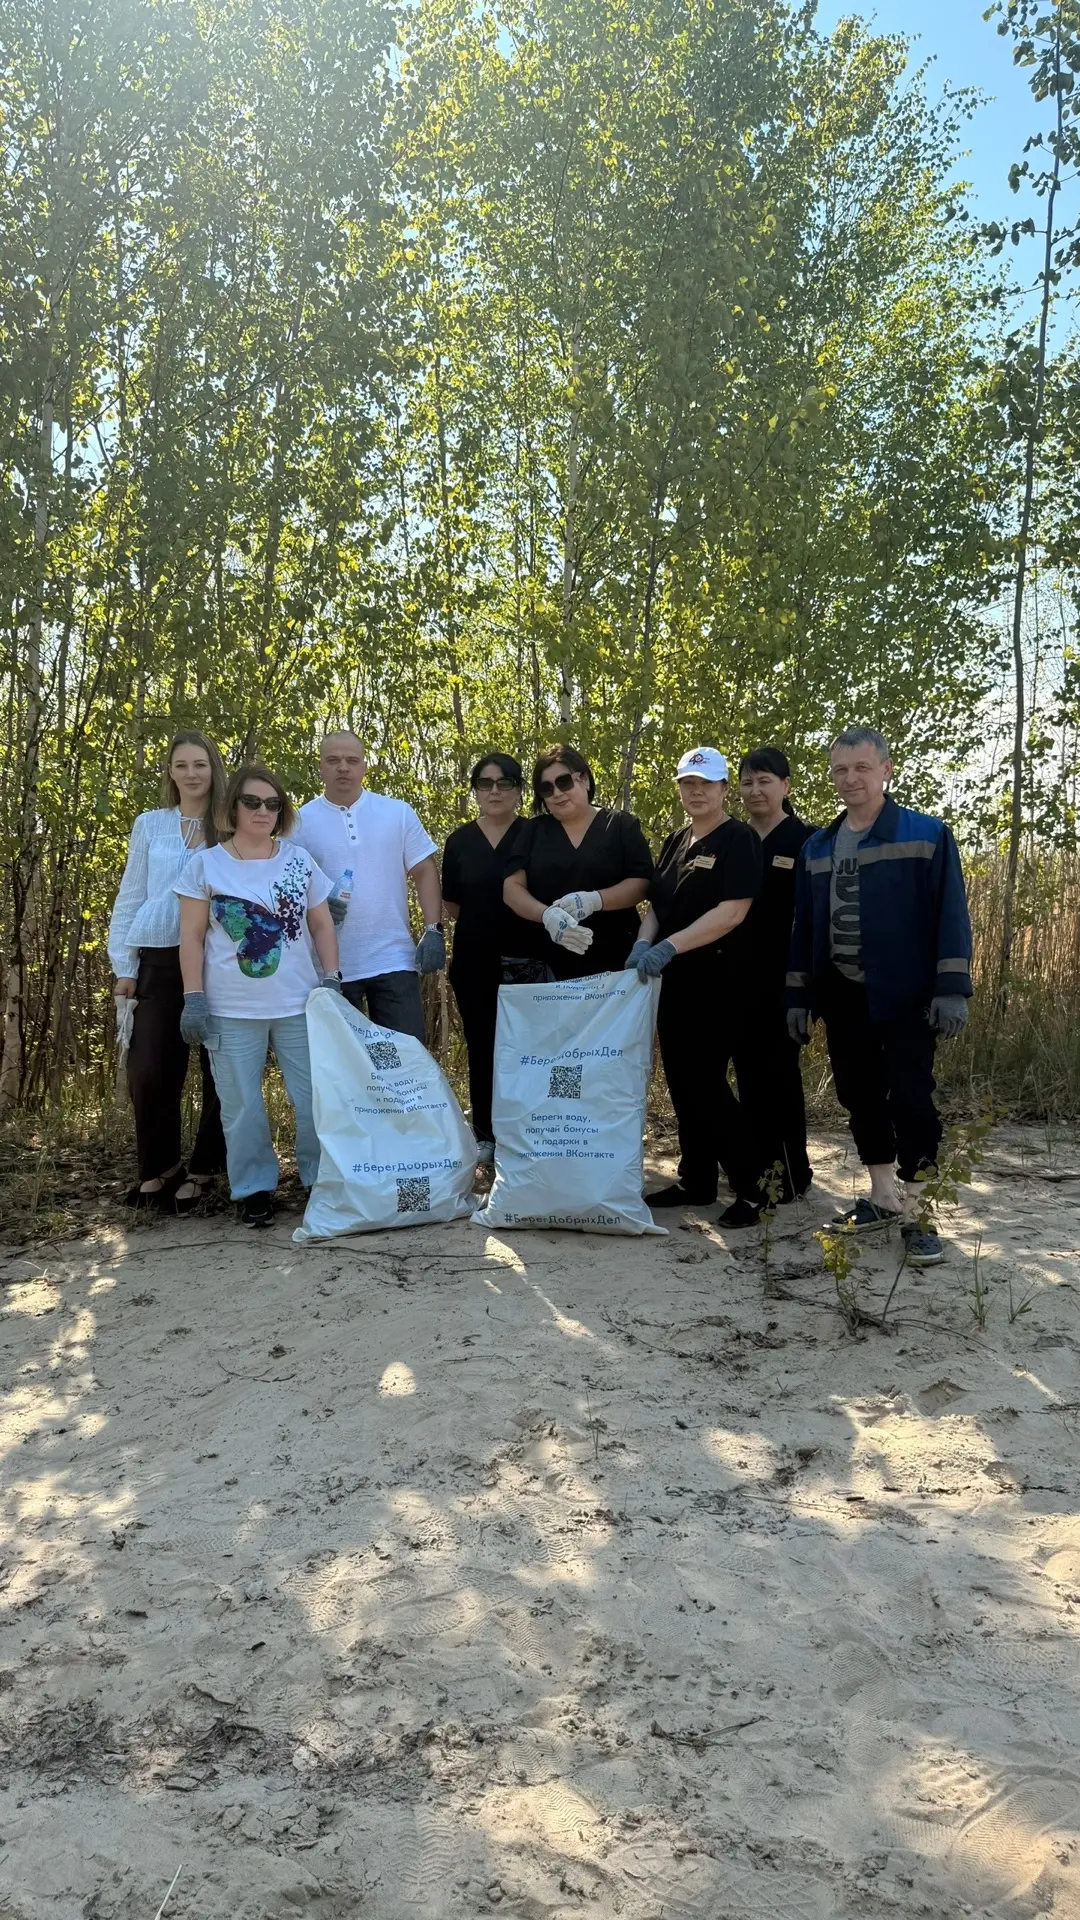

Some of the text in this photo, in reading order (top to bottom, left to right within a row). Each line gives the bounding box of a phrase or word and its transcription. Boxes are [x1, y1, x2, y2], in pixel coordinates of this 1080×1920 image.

[532, 989, 626, 1003] приложении ВКонтакте
[354, 1106, 405, 1115] приложении
[531, 1113, 591, 1123] Береги воду,
[525, 1124, 599, 1135] получай бонусы
[542, 1138, 580, 1146] подарки
[566, 1149, 615, 1159] ВКонтакте
